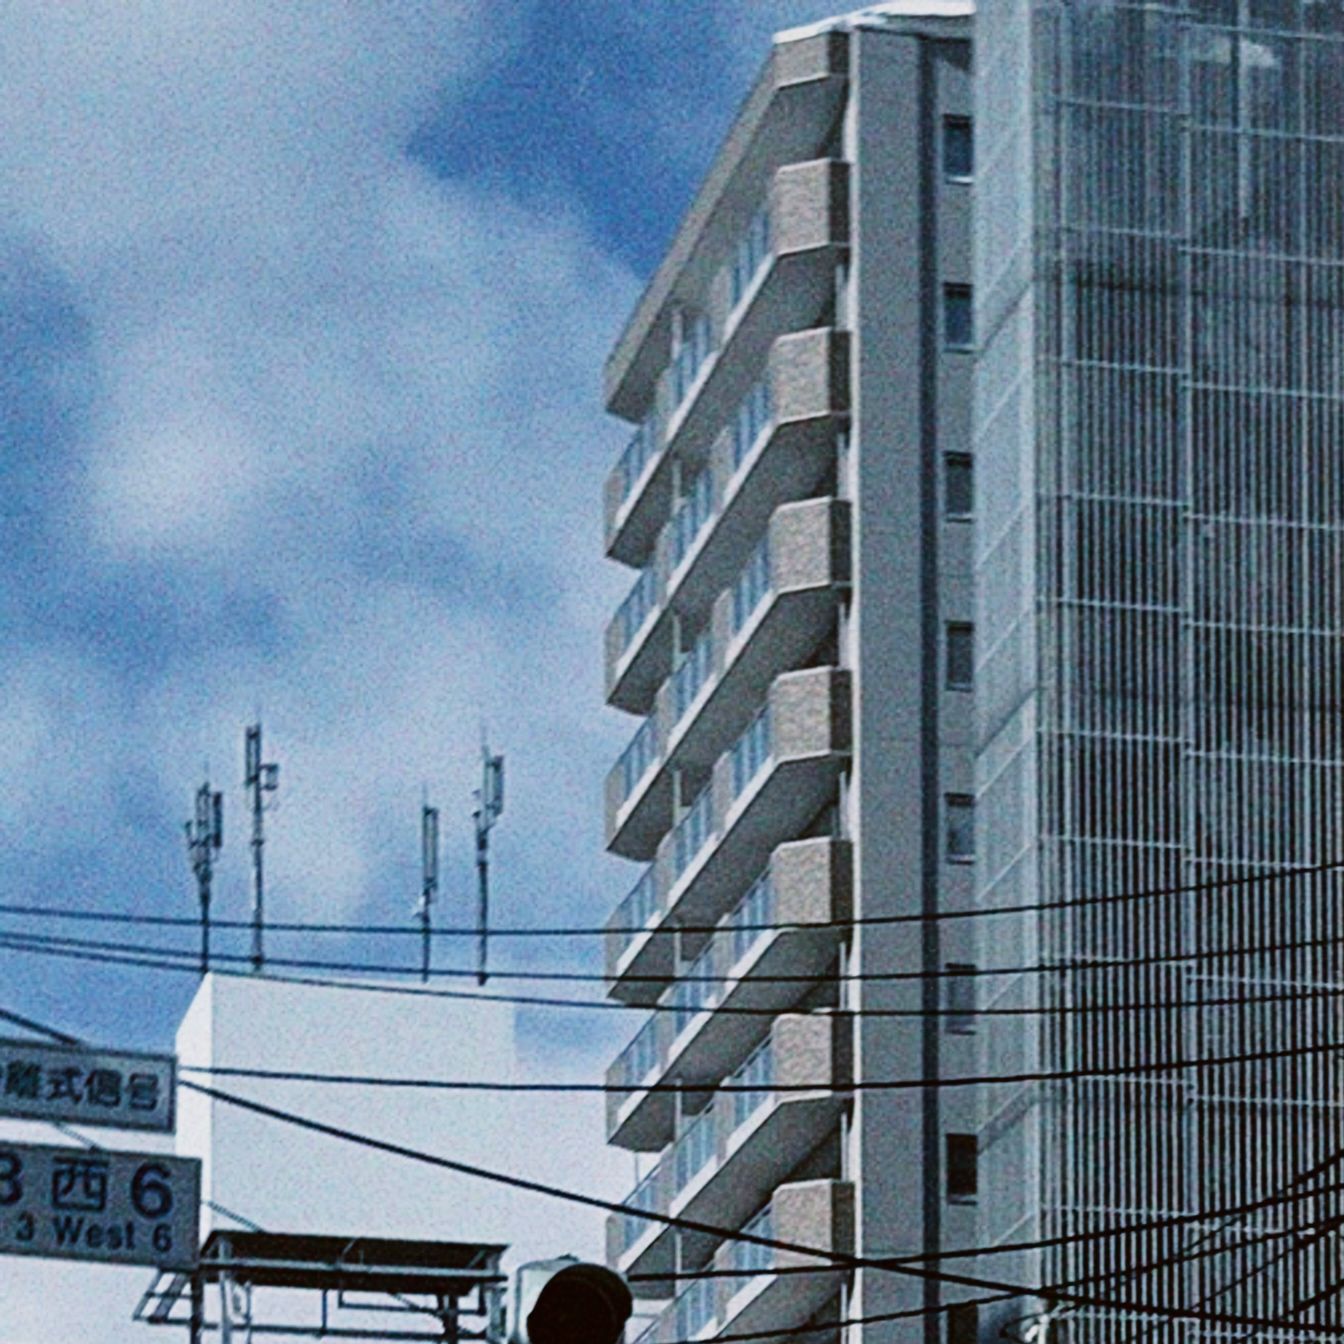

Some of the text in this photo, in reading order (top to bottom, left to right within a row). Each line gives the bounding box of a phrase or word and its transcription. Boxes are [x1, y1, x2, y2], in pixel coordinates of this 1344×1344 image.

[15, 1210, 174, 1254] 3 West 6
